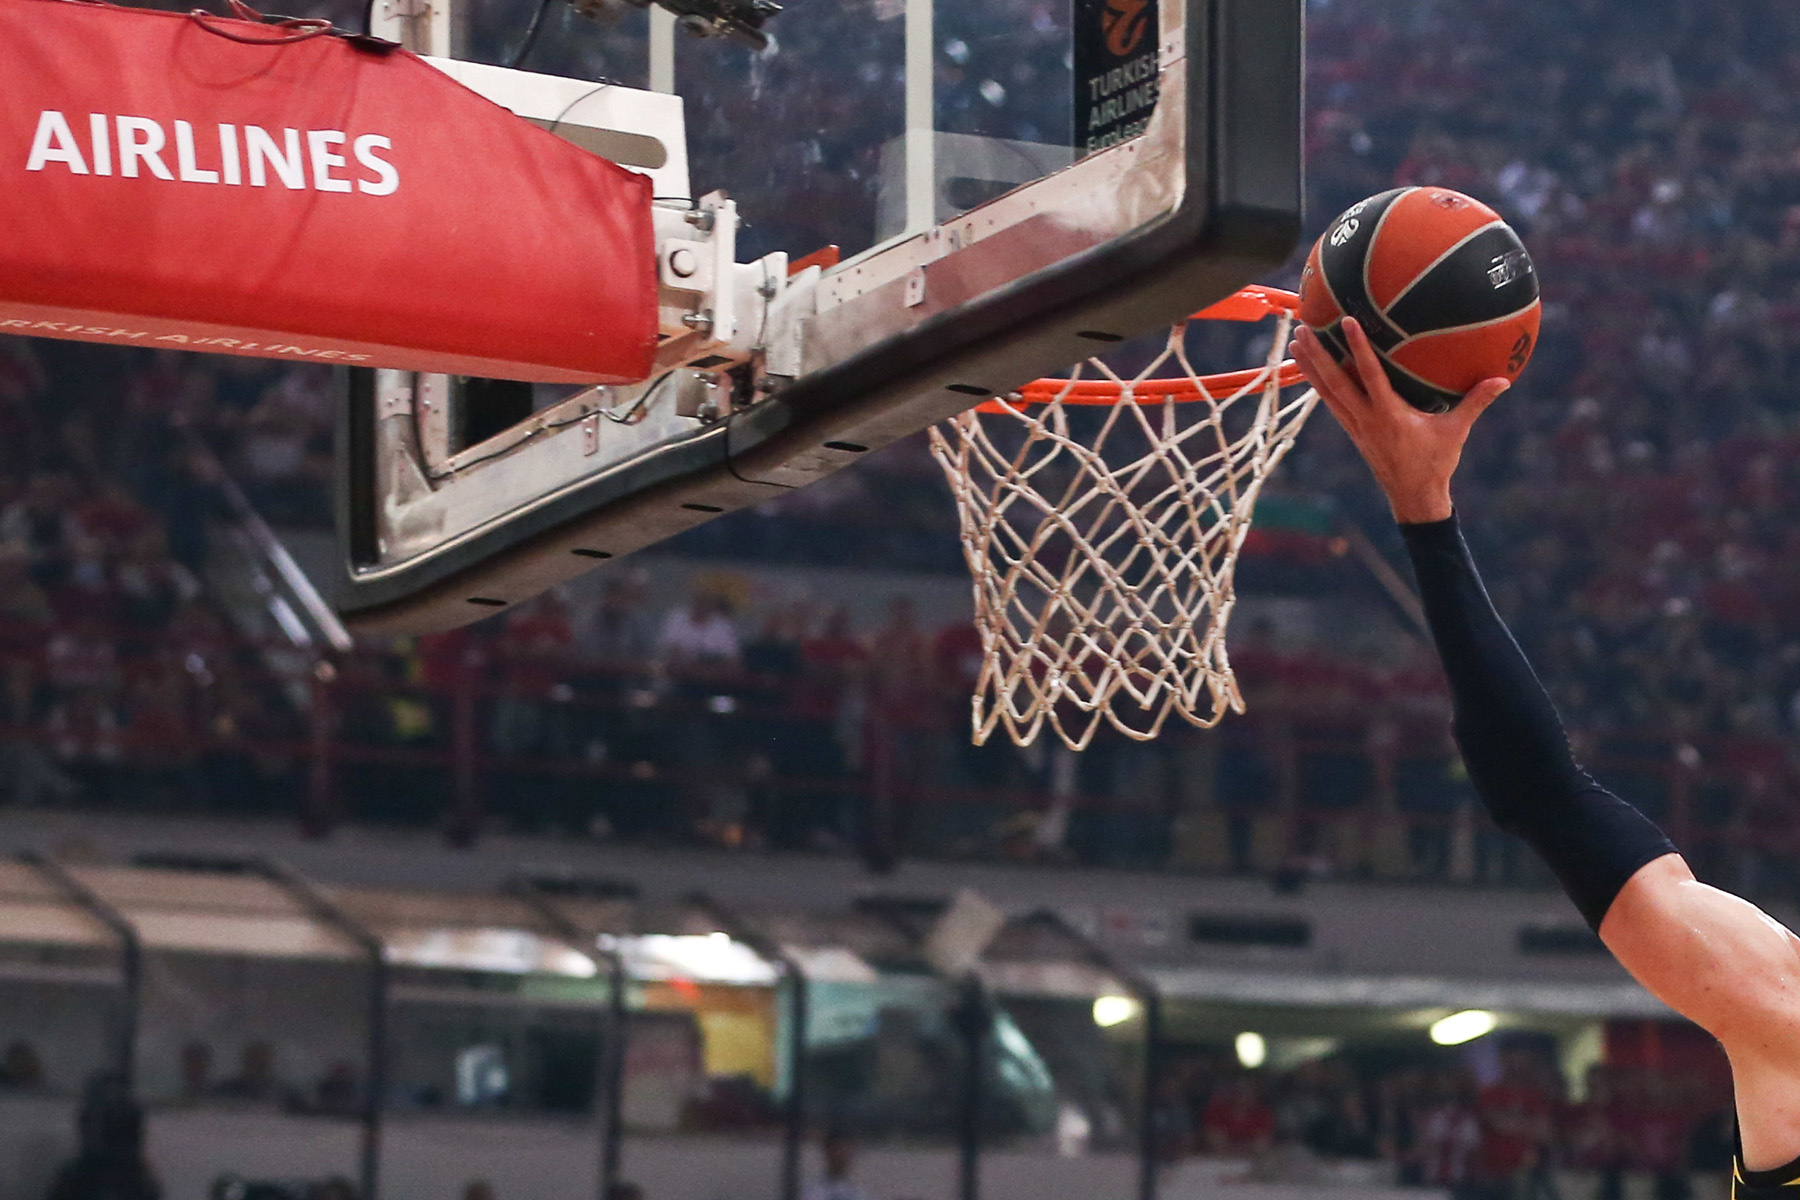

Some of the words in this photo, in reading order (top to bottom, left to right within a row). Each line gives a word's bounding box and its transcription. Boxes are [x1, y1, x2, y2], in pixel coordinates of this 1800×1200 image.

[25, 110, 400, 196] AIRLINES
[0, 318, 147, 339] RKISH
[154, 334, 373, 362] AIRLINES
